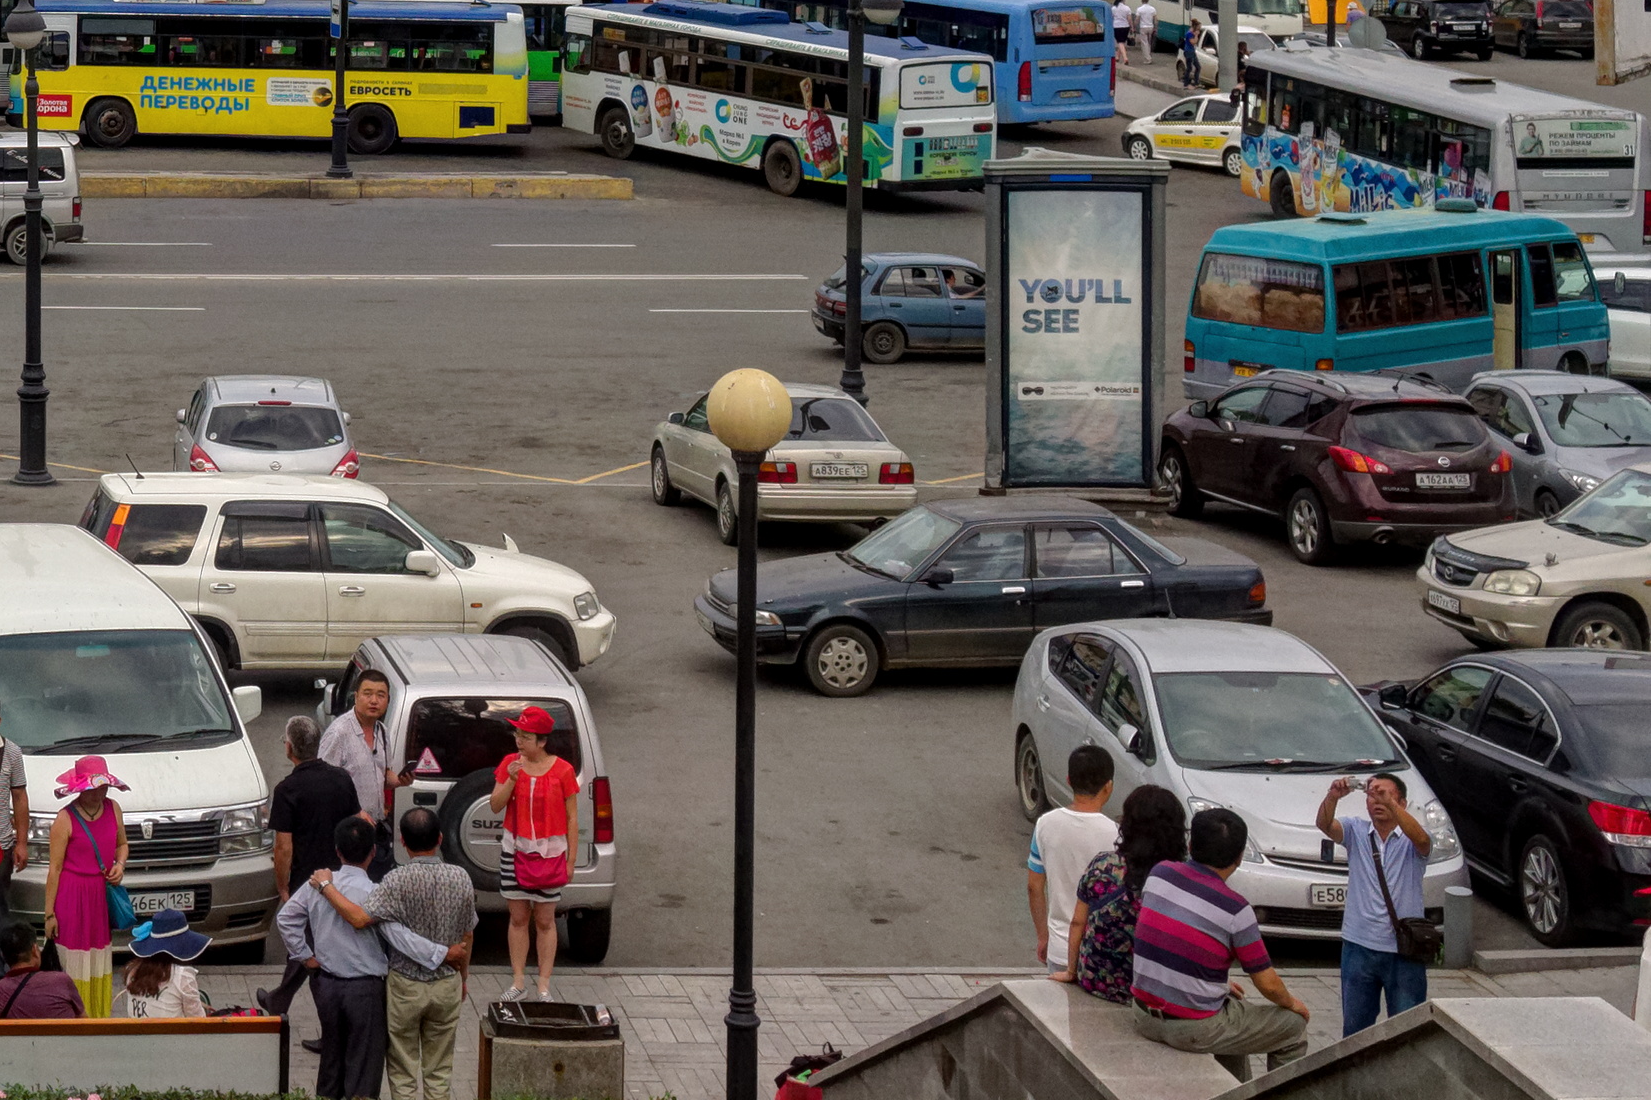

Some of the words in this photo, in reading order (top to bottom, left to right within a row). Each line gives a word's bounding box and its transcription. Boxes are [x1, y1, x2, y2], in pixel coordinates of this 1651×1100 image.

[649, 20, 680, 30] МАГАЗИНАХ
[680, 25, 701, 33] ГОРОДА
[140, 75, 256, 93] ДЕНЕЖНЫЕ
[349, 86, 412, 97] ЕВРОСЕТЬ
[140, 95, 250, 115] ПЕРЕВОДЫ
[732, 103, 748, 112] CHUNG
[732, 116, 748, 125] ONE
[719, 129, 735, 139] Марка
[726, 138, 741, 147] Корее
[1624, 144, 1634, 156] 31
[1018, 278, 1132, 304] YOU'LL
[1021, 308, 1080, 334] SEE
[1100, 385, 1132, 394] Polaroid
[815, 465, 851, 476] А839ЕЕ
[852, 466, 866, 475] 125
[1419, 475, 1454, 486] А162АА
[472, 819, 504, 829] SUZ
[1317, 887, 1347, 903] Е58
[131, 896, 167, 911] 46ЕК
[169, 894, 191, 905] 125
[132, 998, 149, 1019] PER
